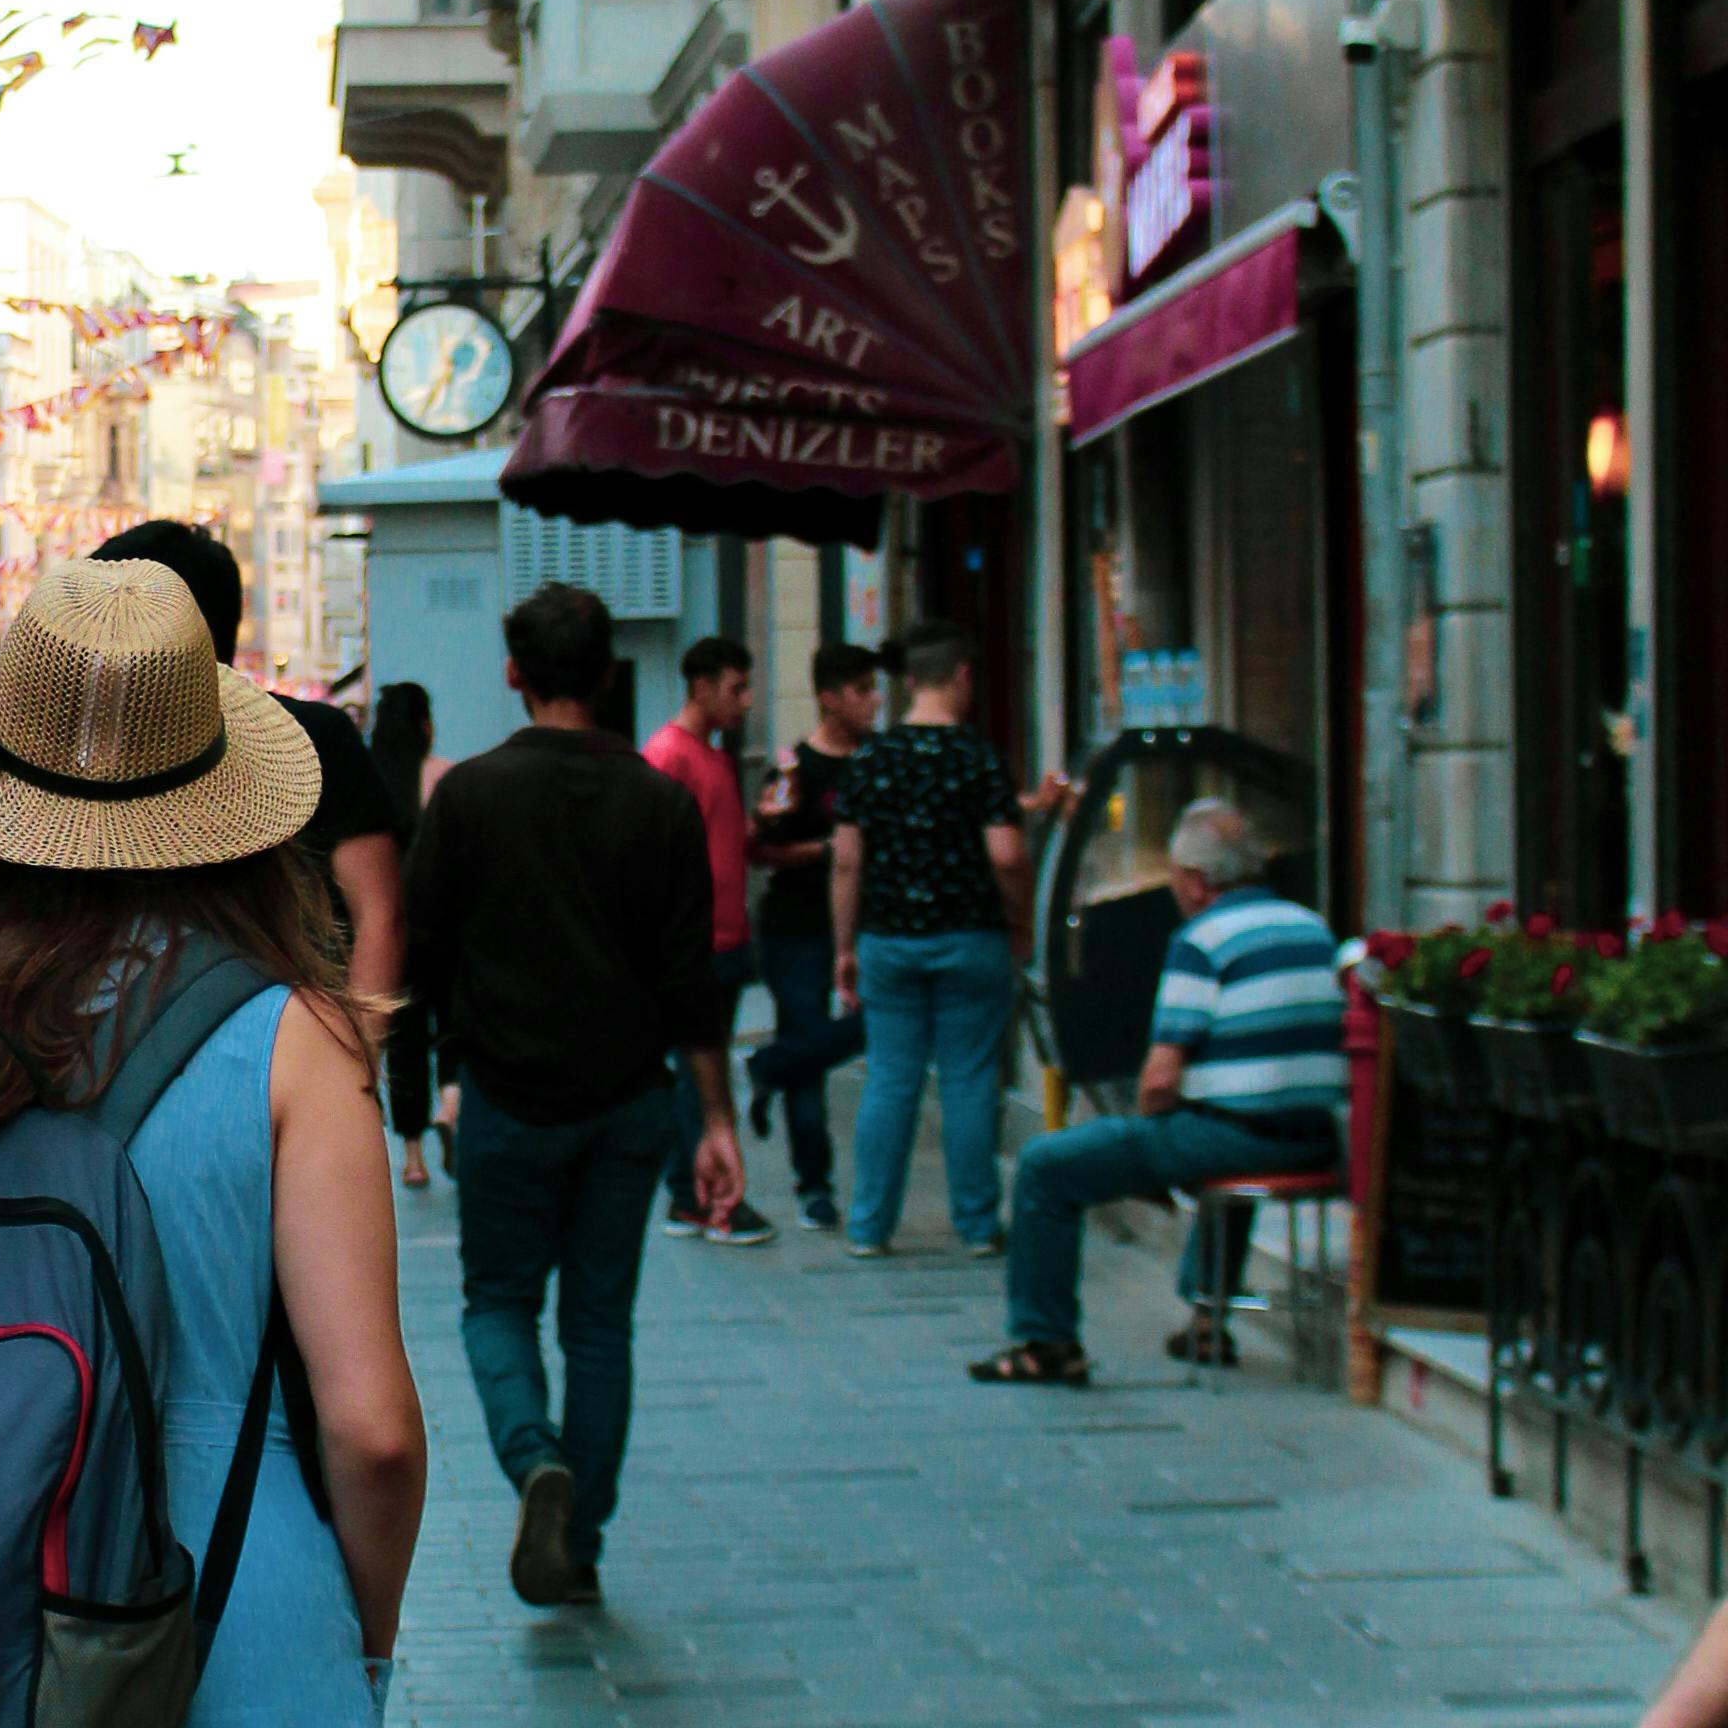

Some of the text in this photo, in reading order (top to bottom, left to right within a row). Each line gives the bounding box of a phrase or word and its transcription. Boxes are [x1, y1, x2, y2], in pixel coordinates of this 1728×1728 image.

[833, 102, 961, 285] MAPS
[944, 21, 1018, 260] BOOKS
[760, 294, 885, 370] ART
